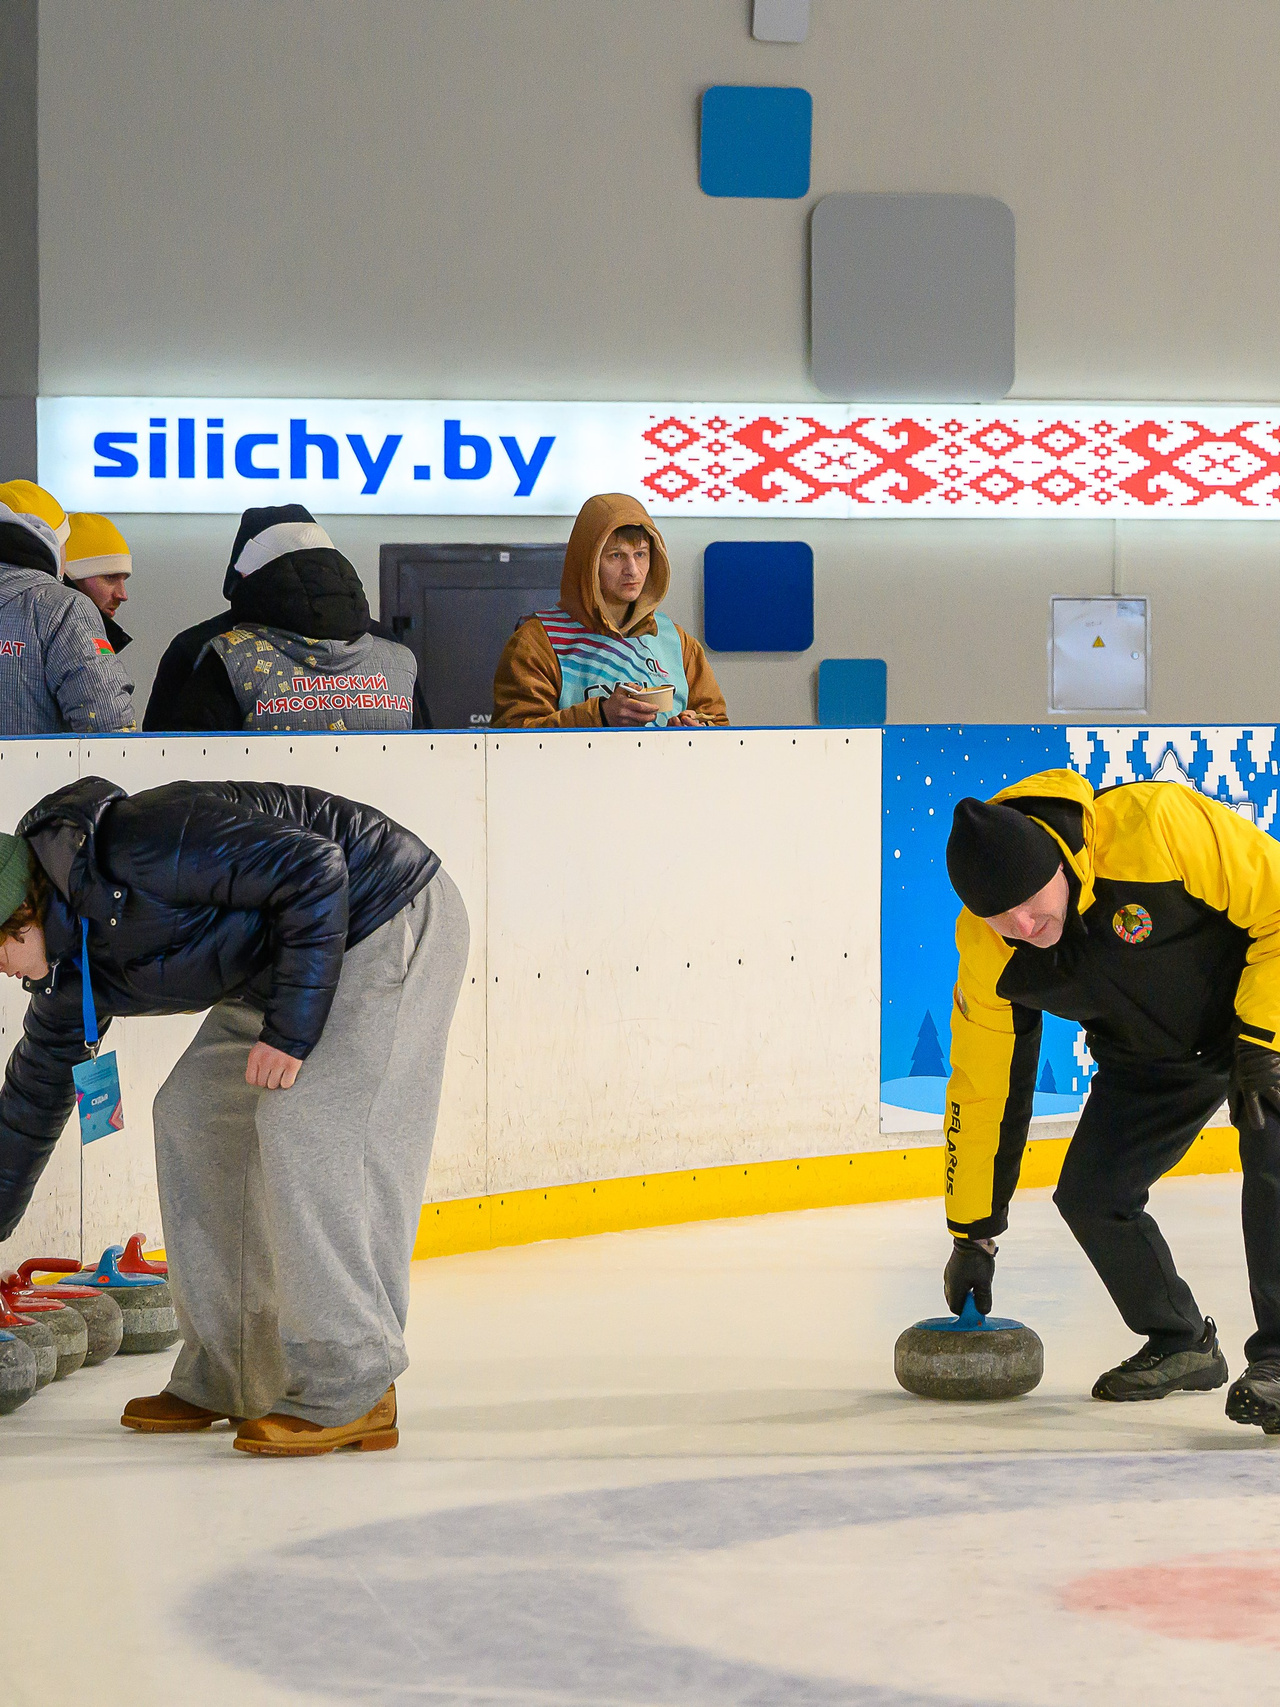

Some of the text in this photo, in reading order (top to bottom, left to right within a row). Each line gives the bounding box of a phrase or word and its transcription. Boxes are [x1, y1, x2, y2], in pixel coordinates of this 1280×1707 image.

[93, 418, 556, 496] silichy.by
[292, 673, 389, 692] ПИНСКИЙ
[946, 1101, 961, 1196] BELARUS
